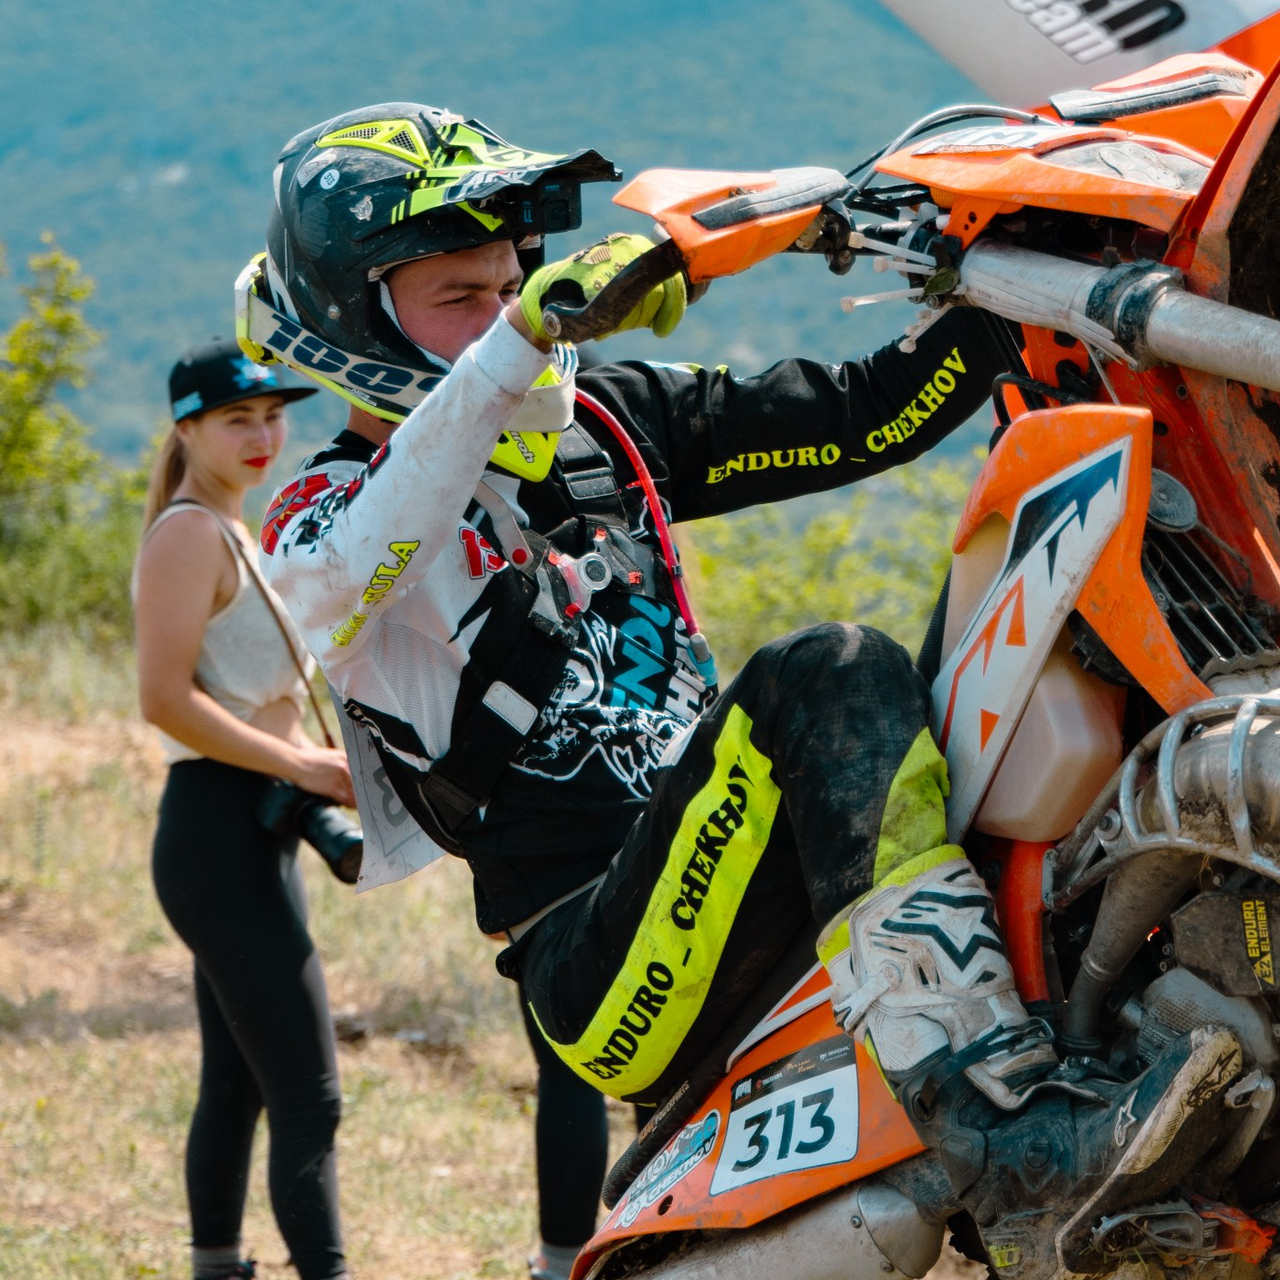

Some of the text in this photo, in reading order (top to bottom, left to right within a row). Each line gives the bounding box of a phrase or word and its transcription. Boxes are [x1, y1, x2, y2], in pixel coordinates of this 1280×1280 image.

[323, 172, 335, 186] 313
[266, 313, 448, 397] 100
[510, 431, 536, 463] iroh
[706, 443, 841, 484] ENDURO
[866, 347, 968, 454] CHEKHOV
[362, 540, 420, 607] TULA
[1242, 900, 1260, 959] ENDURO
[1256, 899, 1271, 952] ELEMENT
[579, 960, 675, 1080] ENDURO
[731, 1088, 836, 1173] 313
[648, 1139, 715, 1203] CHEKHOV
